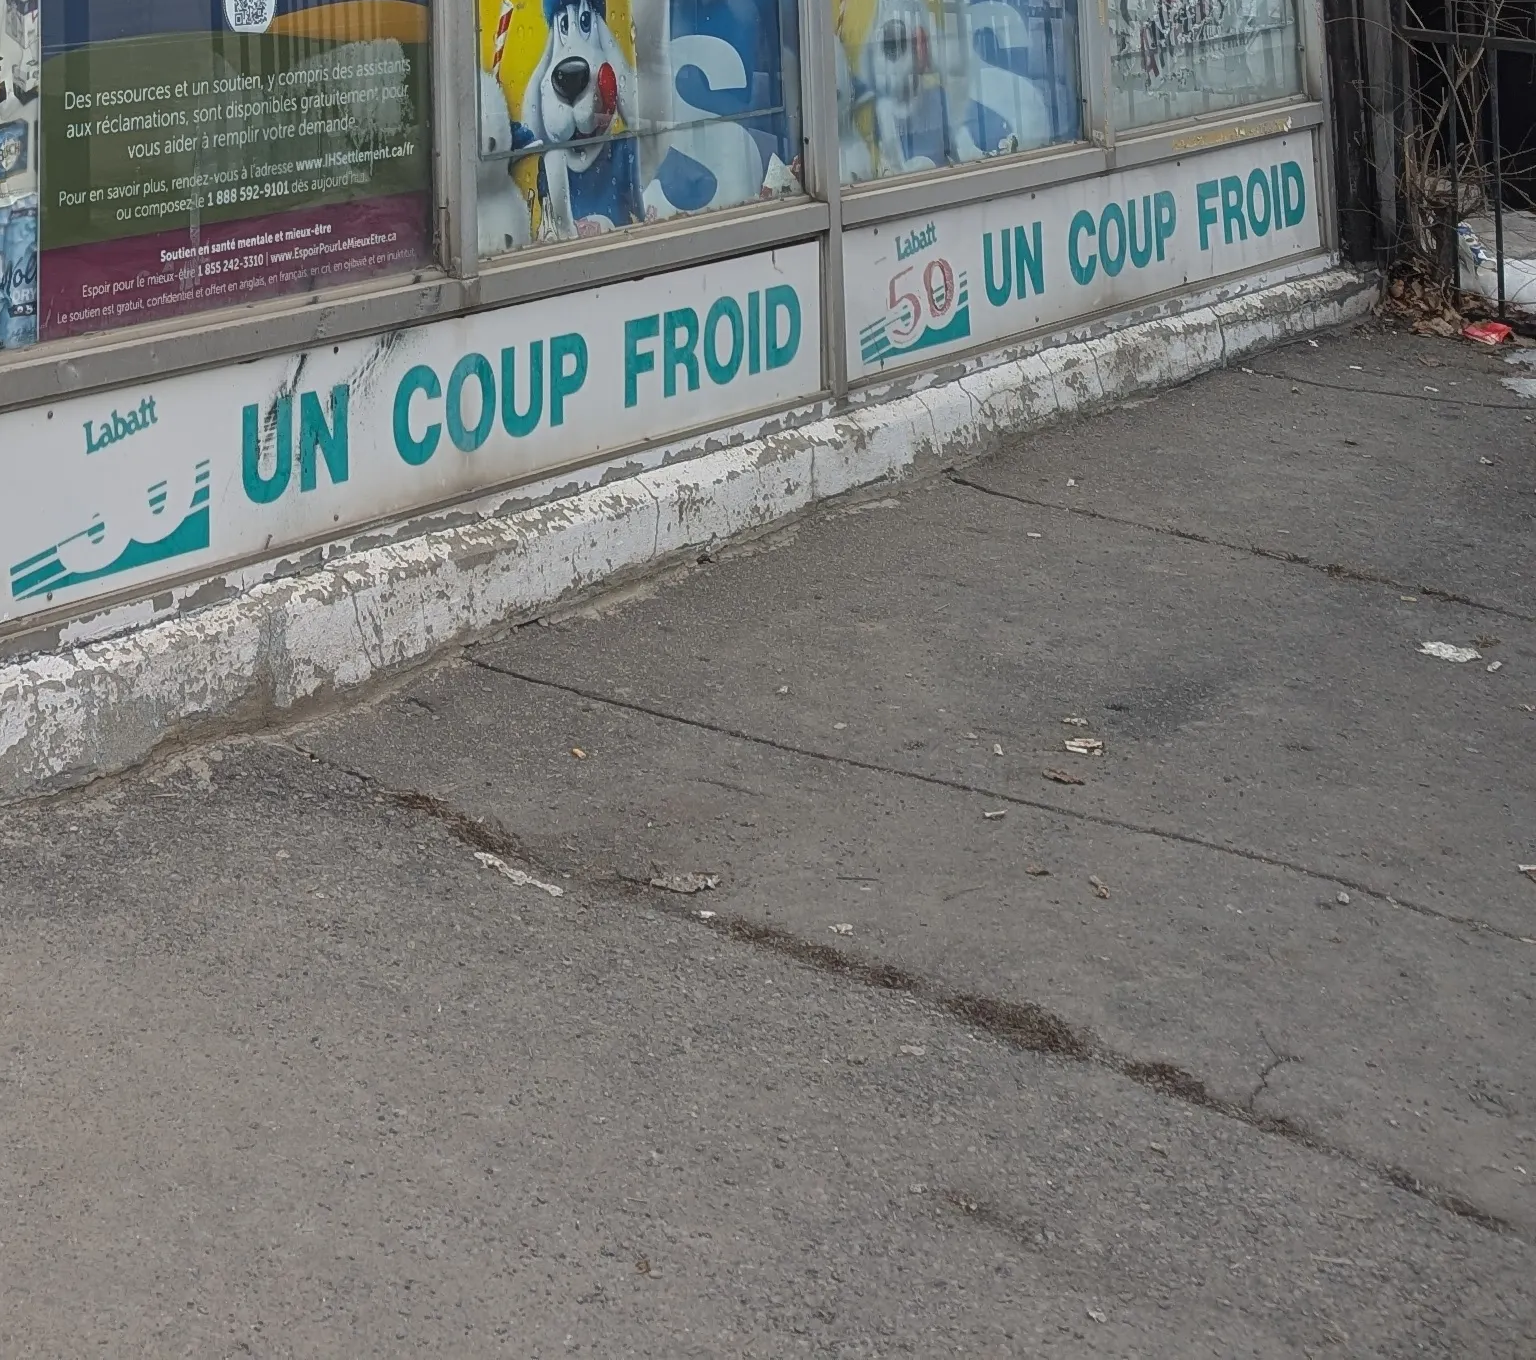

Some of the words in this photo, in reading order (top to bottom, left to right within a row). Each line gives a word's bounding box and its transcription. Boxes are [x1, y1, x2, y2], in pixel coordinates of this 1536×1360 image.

[65, 91, 92, 110] Des
[96, 84, 171, 106] ressources
[175, 81, 188, 97] et
[193, 81, 209, 95] un
[213, 73, 263, 91] soutien,
[268, 74, 275, 91] y
[278, 65, 329, 88] compris
[333, 62, 353, 79] des
[66, 122, 92, 138] aux
[96, 109, 189, 134] réclamations,
[193, 104, 222, 123] sont
[226, 94, 297, 121] disponibles
[382, 84, 409, 103] pour
[638, 35, 764, 211] S
[128, 141, 160, 158] vous
[164, 134, 198, 154] aider
[202, 132, 209, 149] à
[213, 122, 259, 148] remplir
[263, 123, 295, 140] votre
[59, 190, 86, 207] Pour
[90, 188, 103, 202] en
[107, 181, 140, 200] savoir
[143, 179, 168, 197] plus,
[172, 168, 238, 190] rendez-vous
[241, 165, 248, 180] à
[116, 206, 132, 220] ou
[135, 197, 192, 218] composez
[195, 194, 205, 208] le
[208, 192, 213, 206] 1
[216, 189, 237, 205] 888
[240, 180, 289, 201] 592-9101
[292, 177, 308, 194] dès
[161, 246, 196, 262] Soutien
[198, 244, 209, 256] en
[211, 238, 235, 254] santé
[238, 232, 272, 248] mentale
[275, 231, 283, 242] et
[285, 224, 332, 240] mieux-être
[895, 221, 938, 261] Labatt
[983, 221, 1045, 307] UN
[1069, 190, 1177, 286] COUP
[1196, 160, 1306, 251] FROID
[83, 281, 110, 298] Espoir
[113, 279, 134, 295] pour
[137, 276, 145, 288] le
[147, 268, 195, 286] mieux-être
[198, 265, 202, 276] 1
[205, 262, 221, 275] 855
[223, 254, 264, 271] 242-3310
[886, 257, 955, 346] 50
[241, 384, 349, 504] UN
[393, 332, 589, 466] COUP
[624, 283, 801, 408] FROID
[83, 395, 159, 455] Labatt
